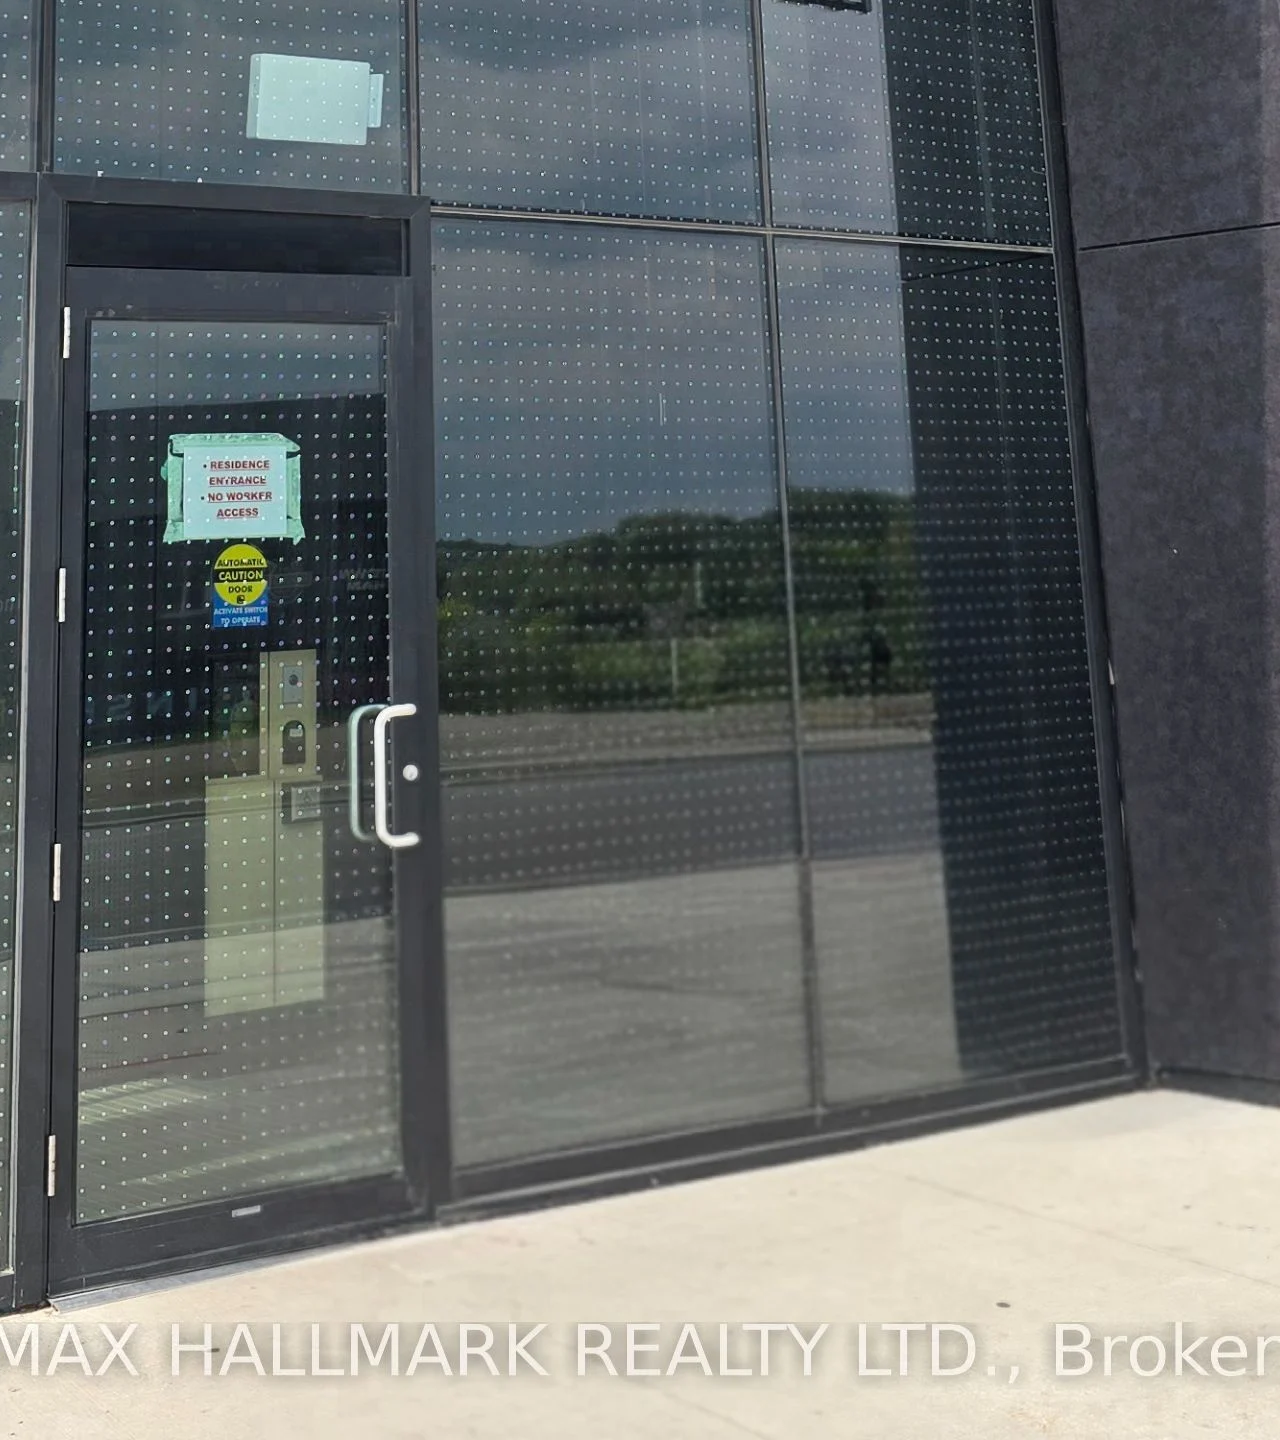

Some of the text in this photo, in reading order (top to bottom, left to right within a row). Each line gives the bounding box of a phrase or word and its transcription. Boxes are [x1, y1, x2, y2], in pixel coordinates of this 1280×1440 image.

[210, 460, 270, 469] RESIDENCE
[209, 475, 267, 485] ENTRANCE
[207, 491, 272, 501] NO WORKER
[216, 508, 258, 517] ACCESS
[218, 558, 264, 567] AUTOMATIC
[218, 570, 263, 581] CAUTION
